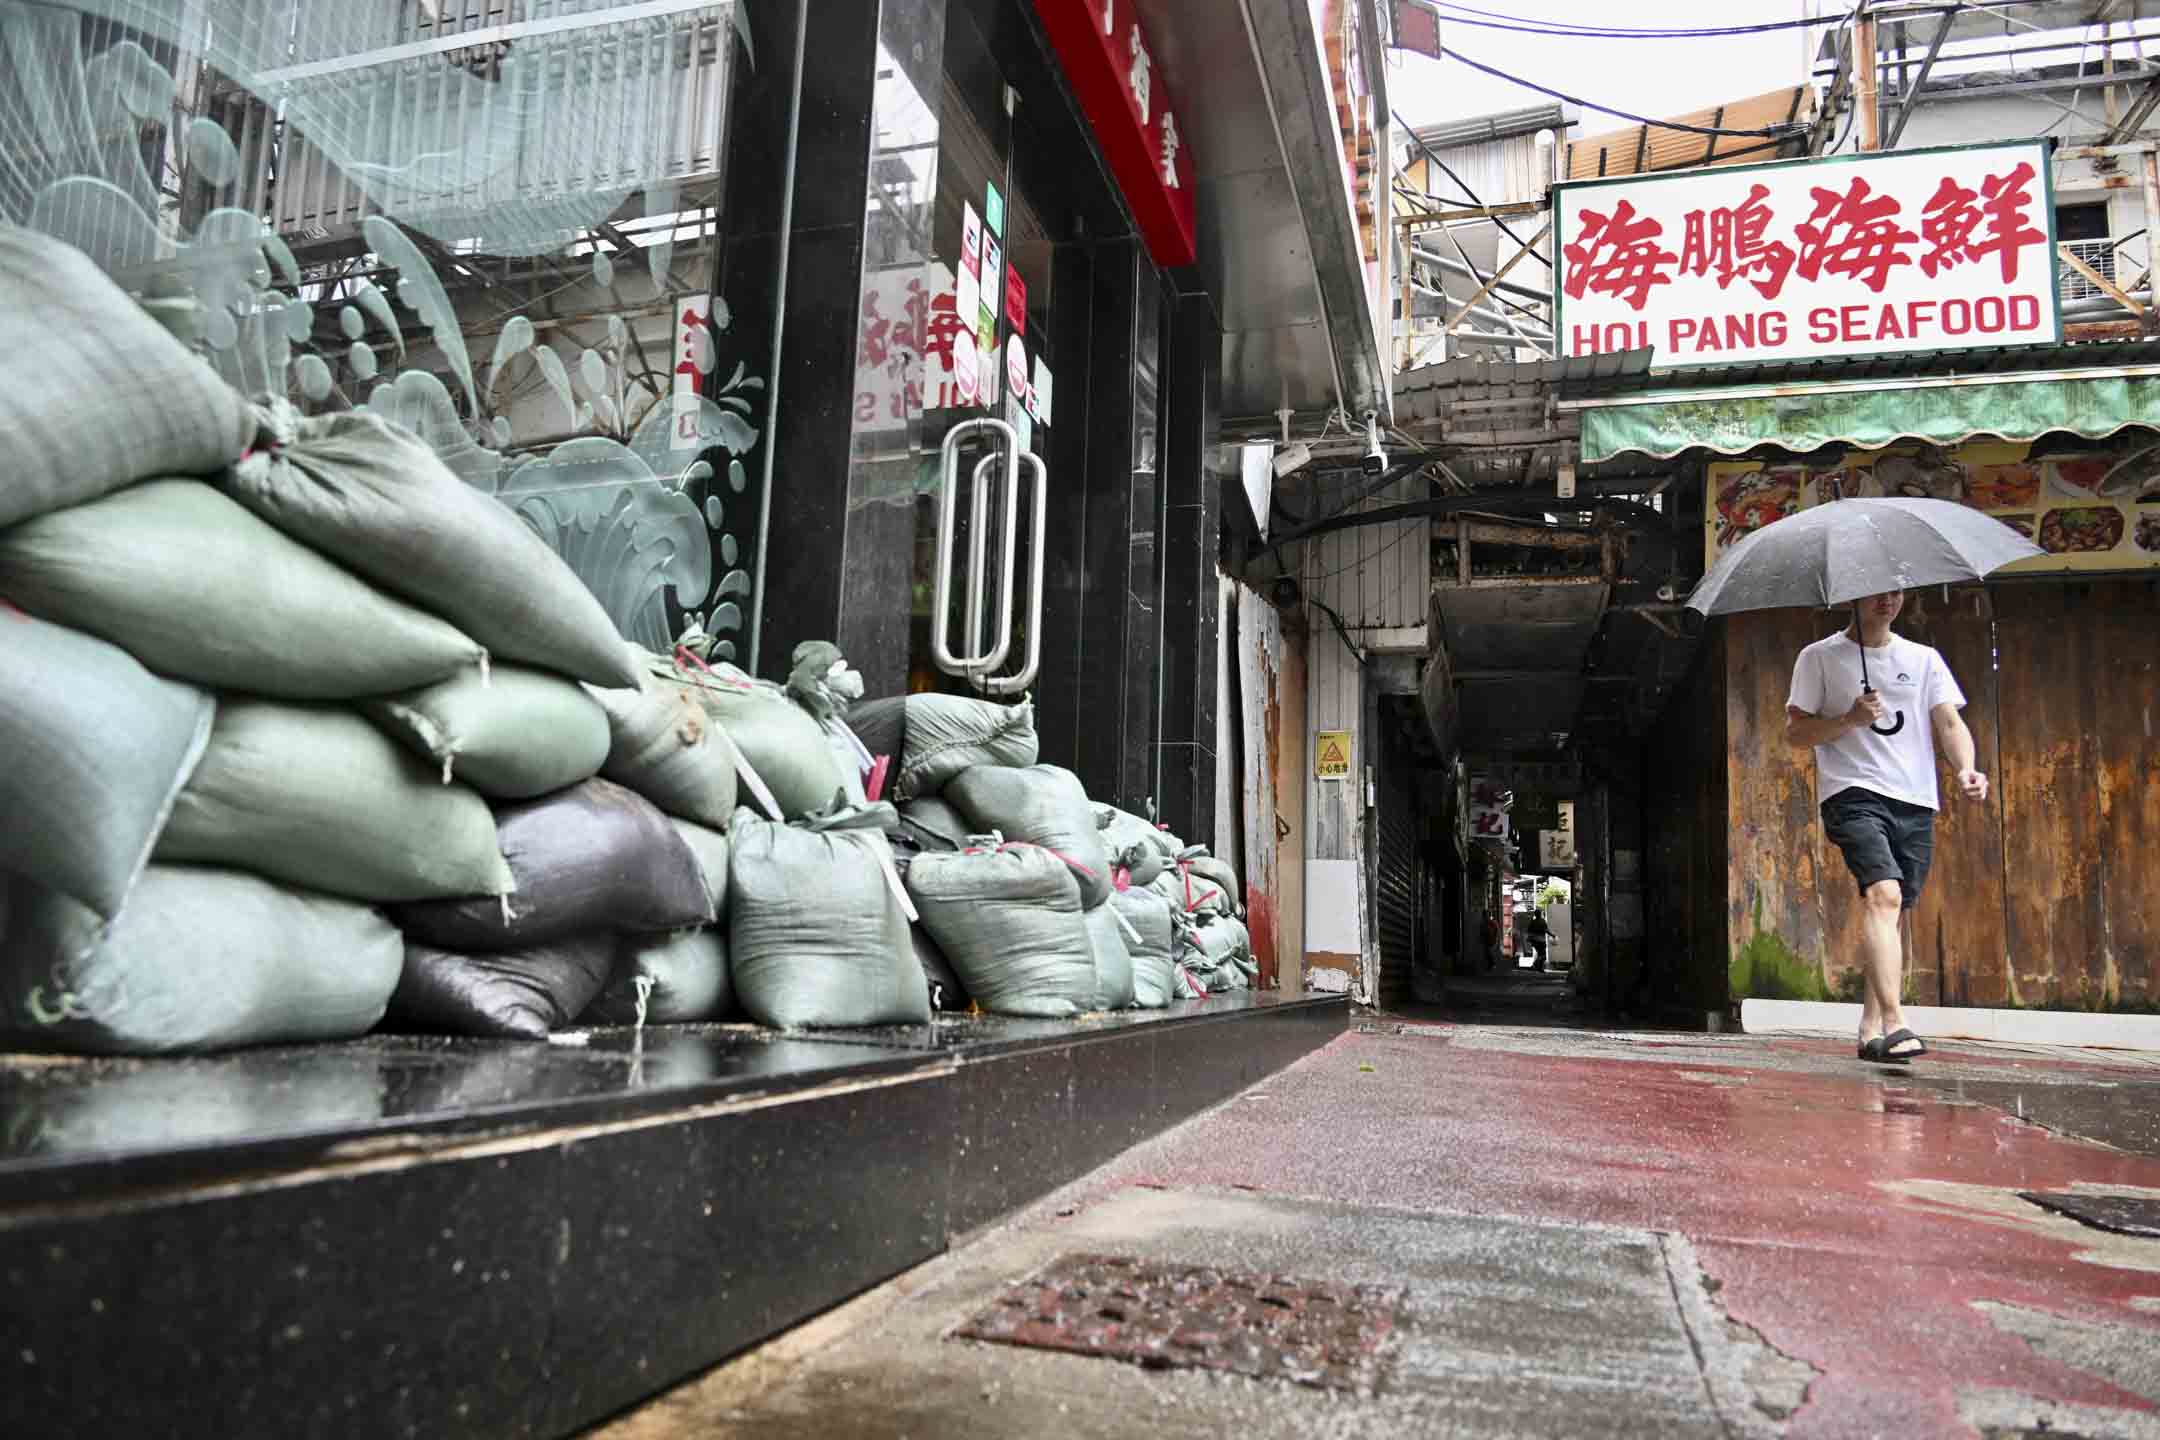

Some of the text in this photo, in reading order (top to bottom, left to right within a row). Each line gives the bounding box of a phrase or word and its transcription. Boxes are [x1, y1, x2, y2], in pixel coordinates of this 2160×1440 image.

[1563, 161, 2047, 311] 海鵬海鮮
[1572, 294, 2040, 357] HOI PANG SEAFOOD
